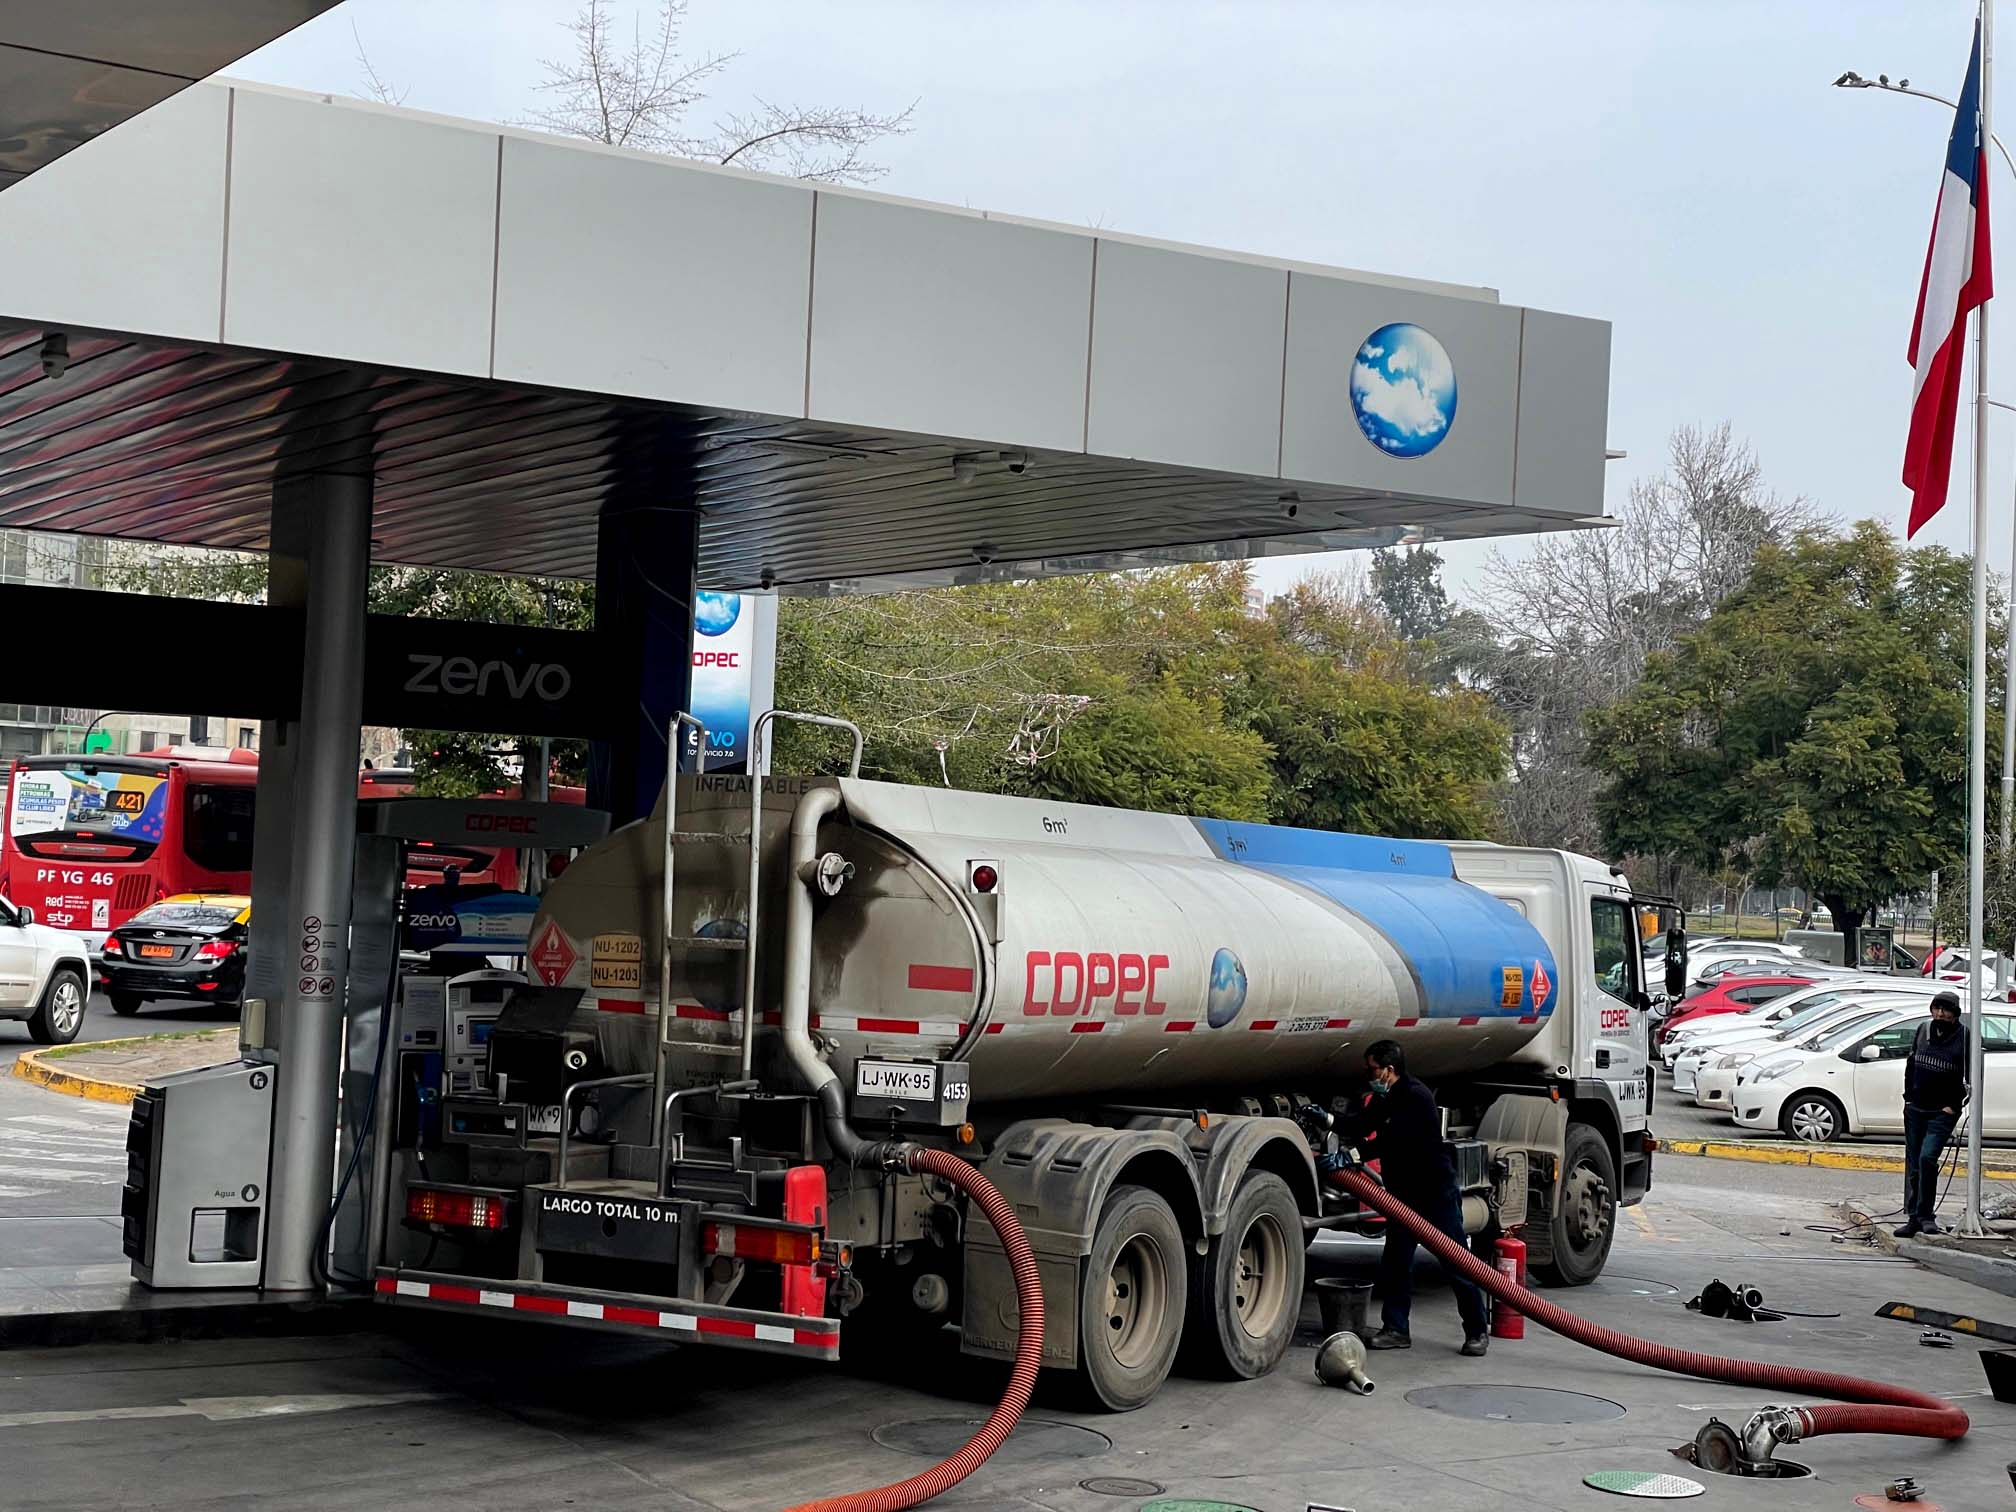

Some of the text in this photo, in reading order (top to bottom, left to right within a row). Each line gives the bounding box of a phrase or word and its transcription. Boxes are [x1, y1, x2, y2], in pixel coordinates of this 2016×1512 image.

[692, 652, 739, 667] OPEC
[404, 654, 571, 700] zervo
[695, 776, 810, 794] INFLAABLE
[116, 793, 142, 810] 421
[37, 869, 114, 886] PF YG 46
[45, 895, 64, 907] Red
[46, 911, 74, 926] stp
[409, 914, 457, 927] zervo
[595, 941, 640, 953] NU-1202
[548, 970, 556, 986] 3
[593, 968, 638, 981] NU-1203
[1023, 951, 1169, 1016] COPEC
[1601, 1009, 1630, 1028] COPEC
[943, 1083, 967, 1099] 4153
[214, 1189, 236, 1198] Agua
[543, 1197, 592, 1215] LARGO
[596, 1202, 641, 1220] TOTAL
[645, 1206, 661, 1222] 10
